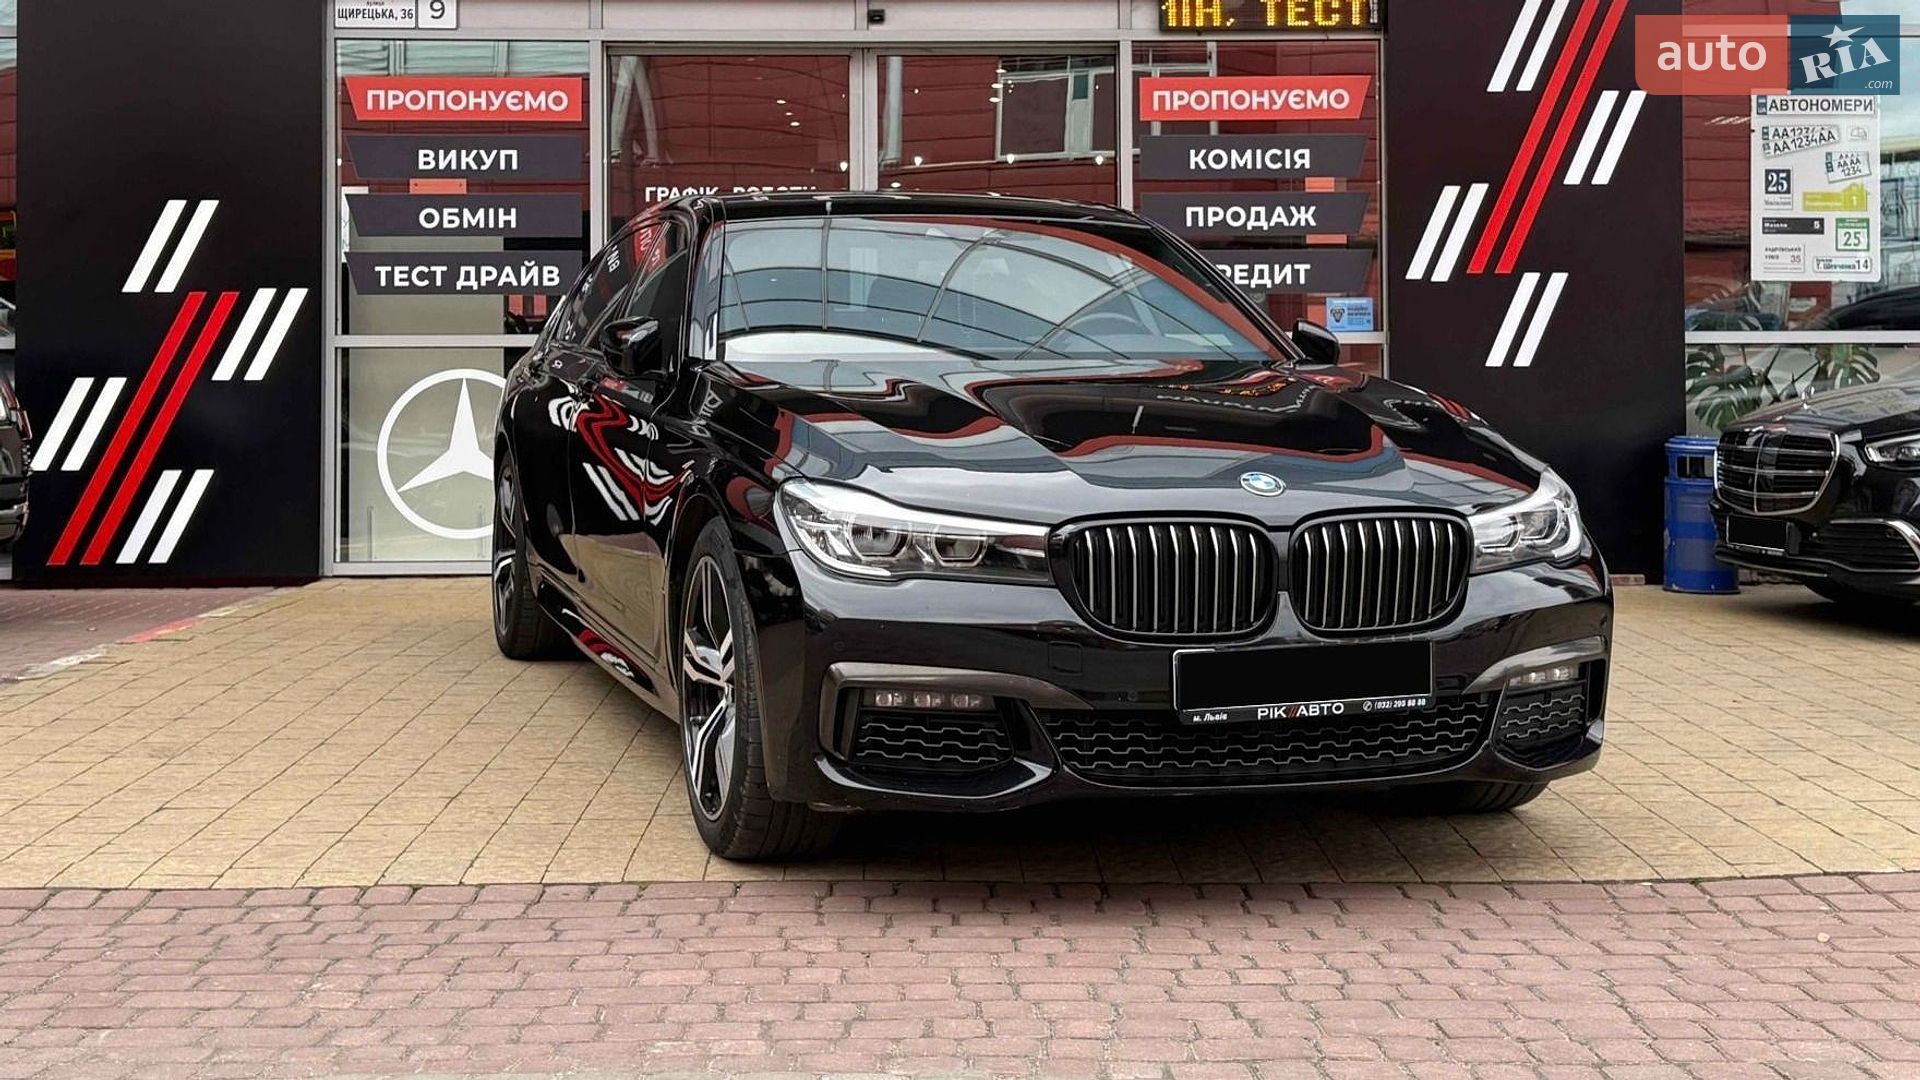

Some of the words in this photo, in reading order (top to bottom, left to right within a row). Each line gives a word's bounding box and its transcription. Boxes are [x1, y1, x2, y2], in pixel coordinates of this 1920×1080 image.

[337, 8, 398, 20] ЩИРЕЦЬКА,
[401, 8, 414, 19] 36
[429, 0, 445, 19] 9
[366, 89, 569, 112] ПРОПОНУЄМО
[1152, 88, 1350, 111] ПРОПОНУЄМО
[1769, 98, 1873, 111] АВТОНОМЕРИ
[417, 149, 519, 171] ВИКУП
[1189, 148, 1311, 170] КОМІСІЯ
[1768, 172, 1788, 192] 25
[418, 208, 518, 229] ОБМІН
[1185, 205, 1317, 230] ПРОДАЖ
[1843, 231, 1861, 247] 25
[1856, 259, 1868, 270] 14
[375, 265, 448, 287] ТЕСТ
[456, 261, 561, 291] ДРАЙВ
